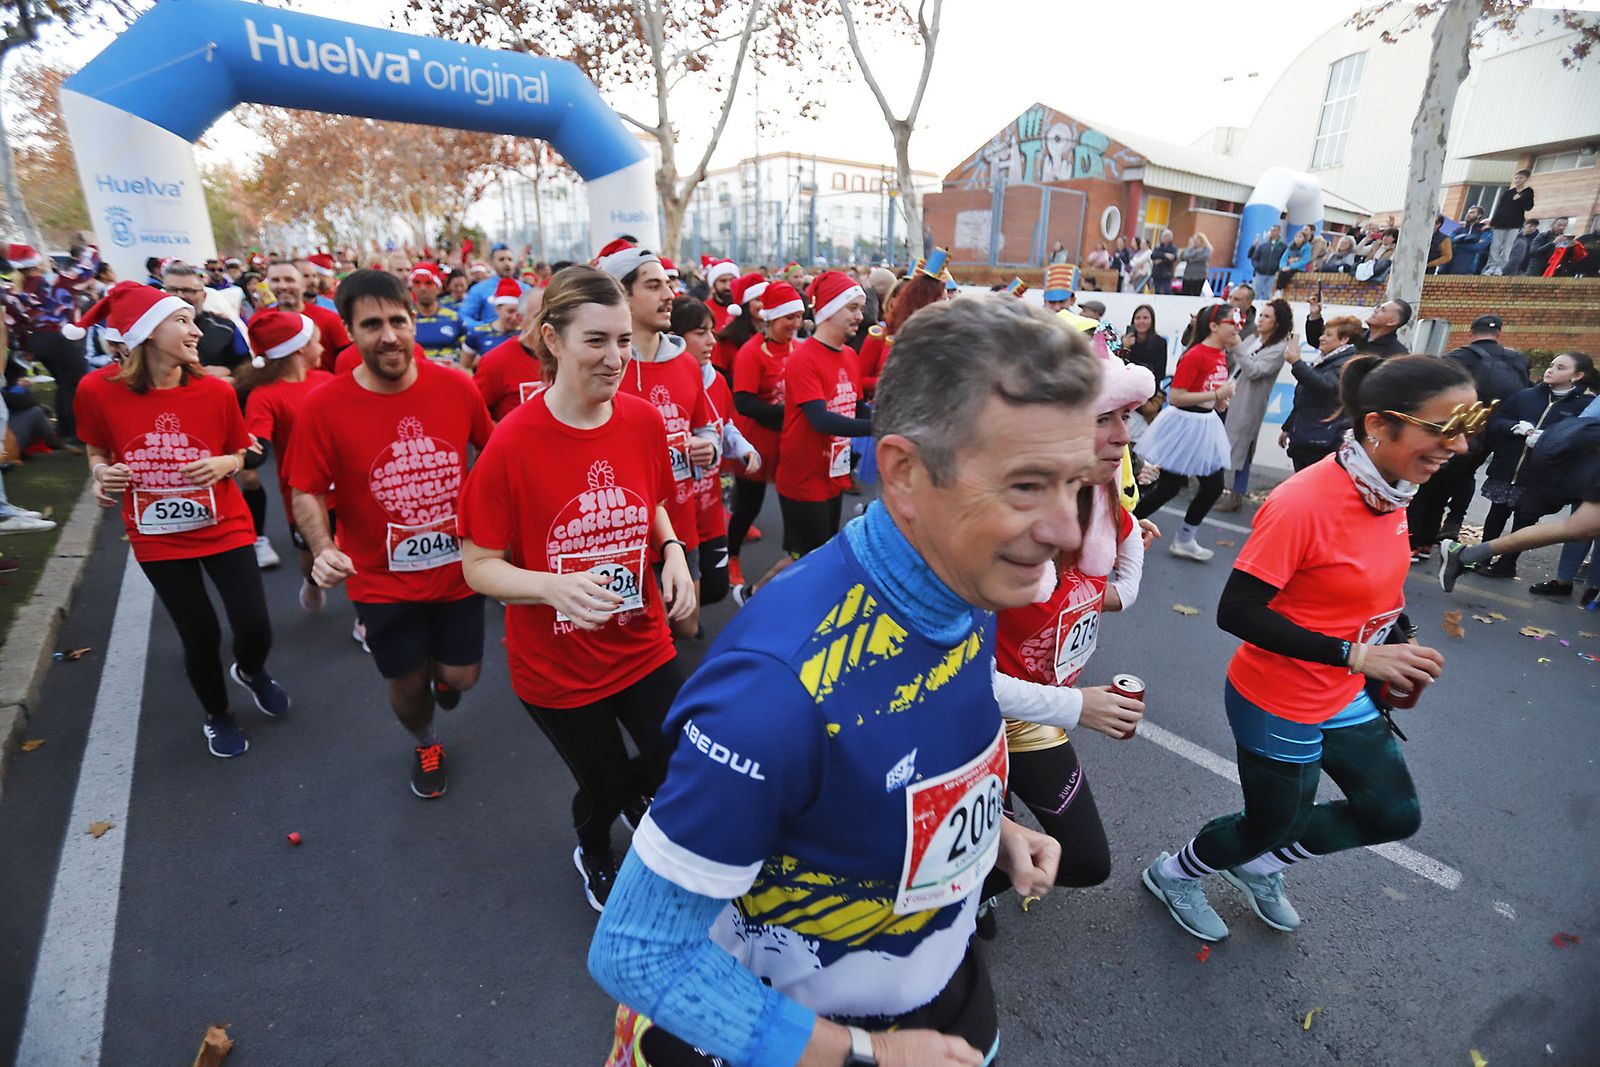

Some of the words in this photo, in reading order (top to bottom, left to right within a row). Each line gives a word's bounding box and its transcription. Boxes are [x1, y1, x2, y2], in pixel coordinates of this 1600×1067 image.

[244, 18, 411, 85] Huelva
[423, 56, 549, 106] original
[95, 174, 182, 198] Huelva
[140, 234, 191, 244] HUELVA
[145, 432, 189, 448] XIII
[391, 436, 436, 458] XIII
[373, 450, 459, 480] CARRERA
[155, 501, 195, 520] 529
[578, 487, 627, 514] XIII
[553, 505, 648, 540] CARRERA
[407, 534, 442, 556] 204
[547, 536, 586, 555] SAN
